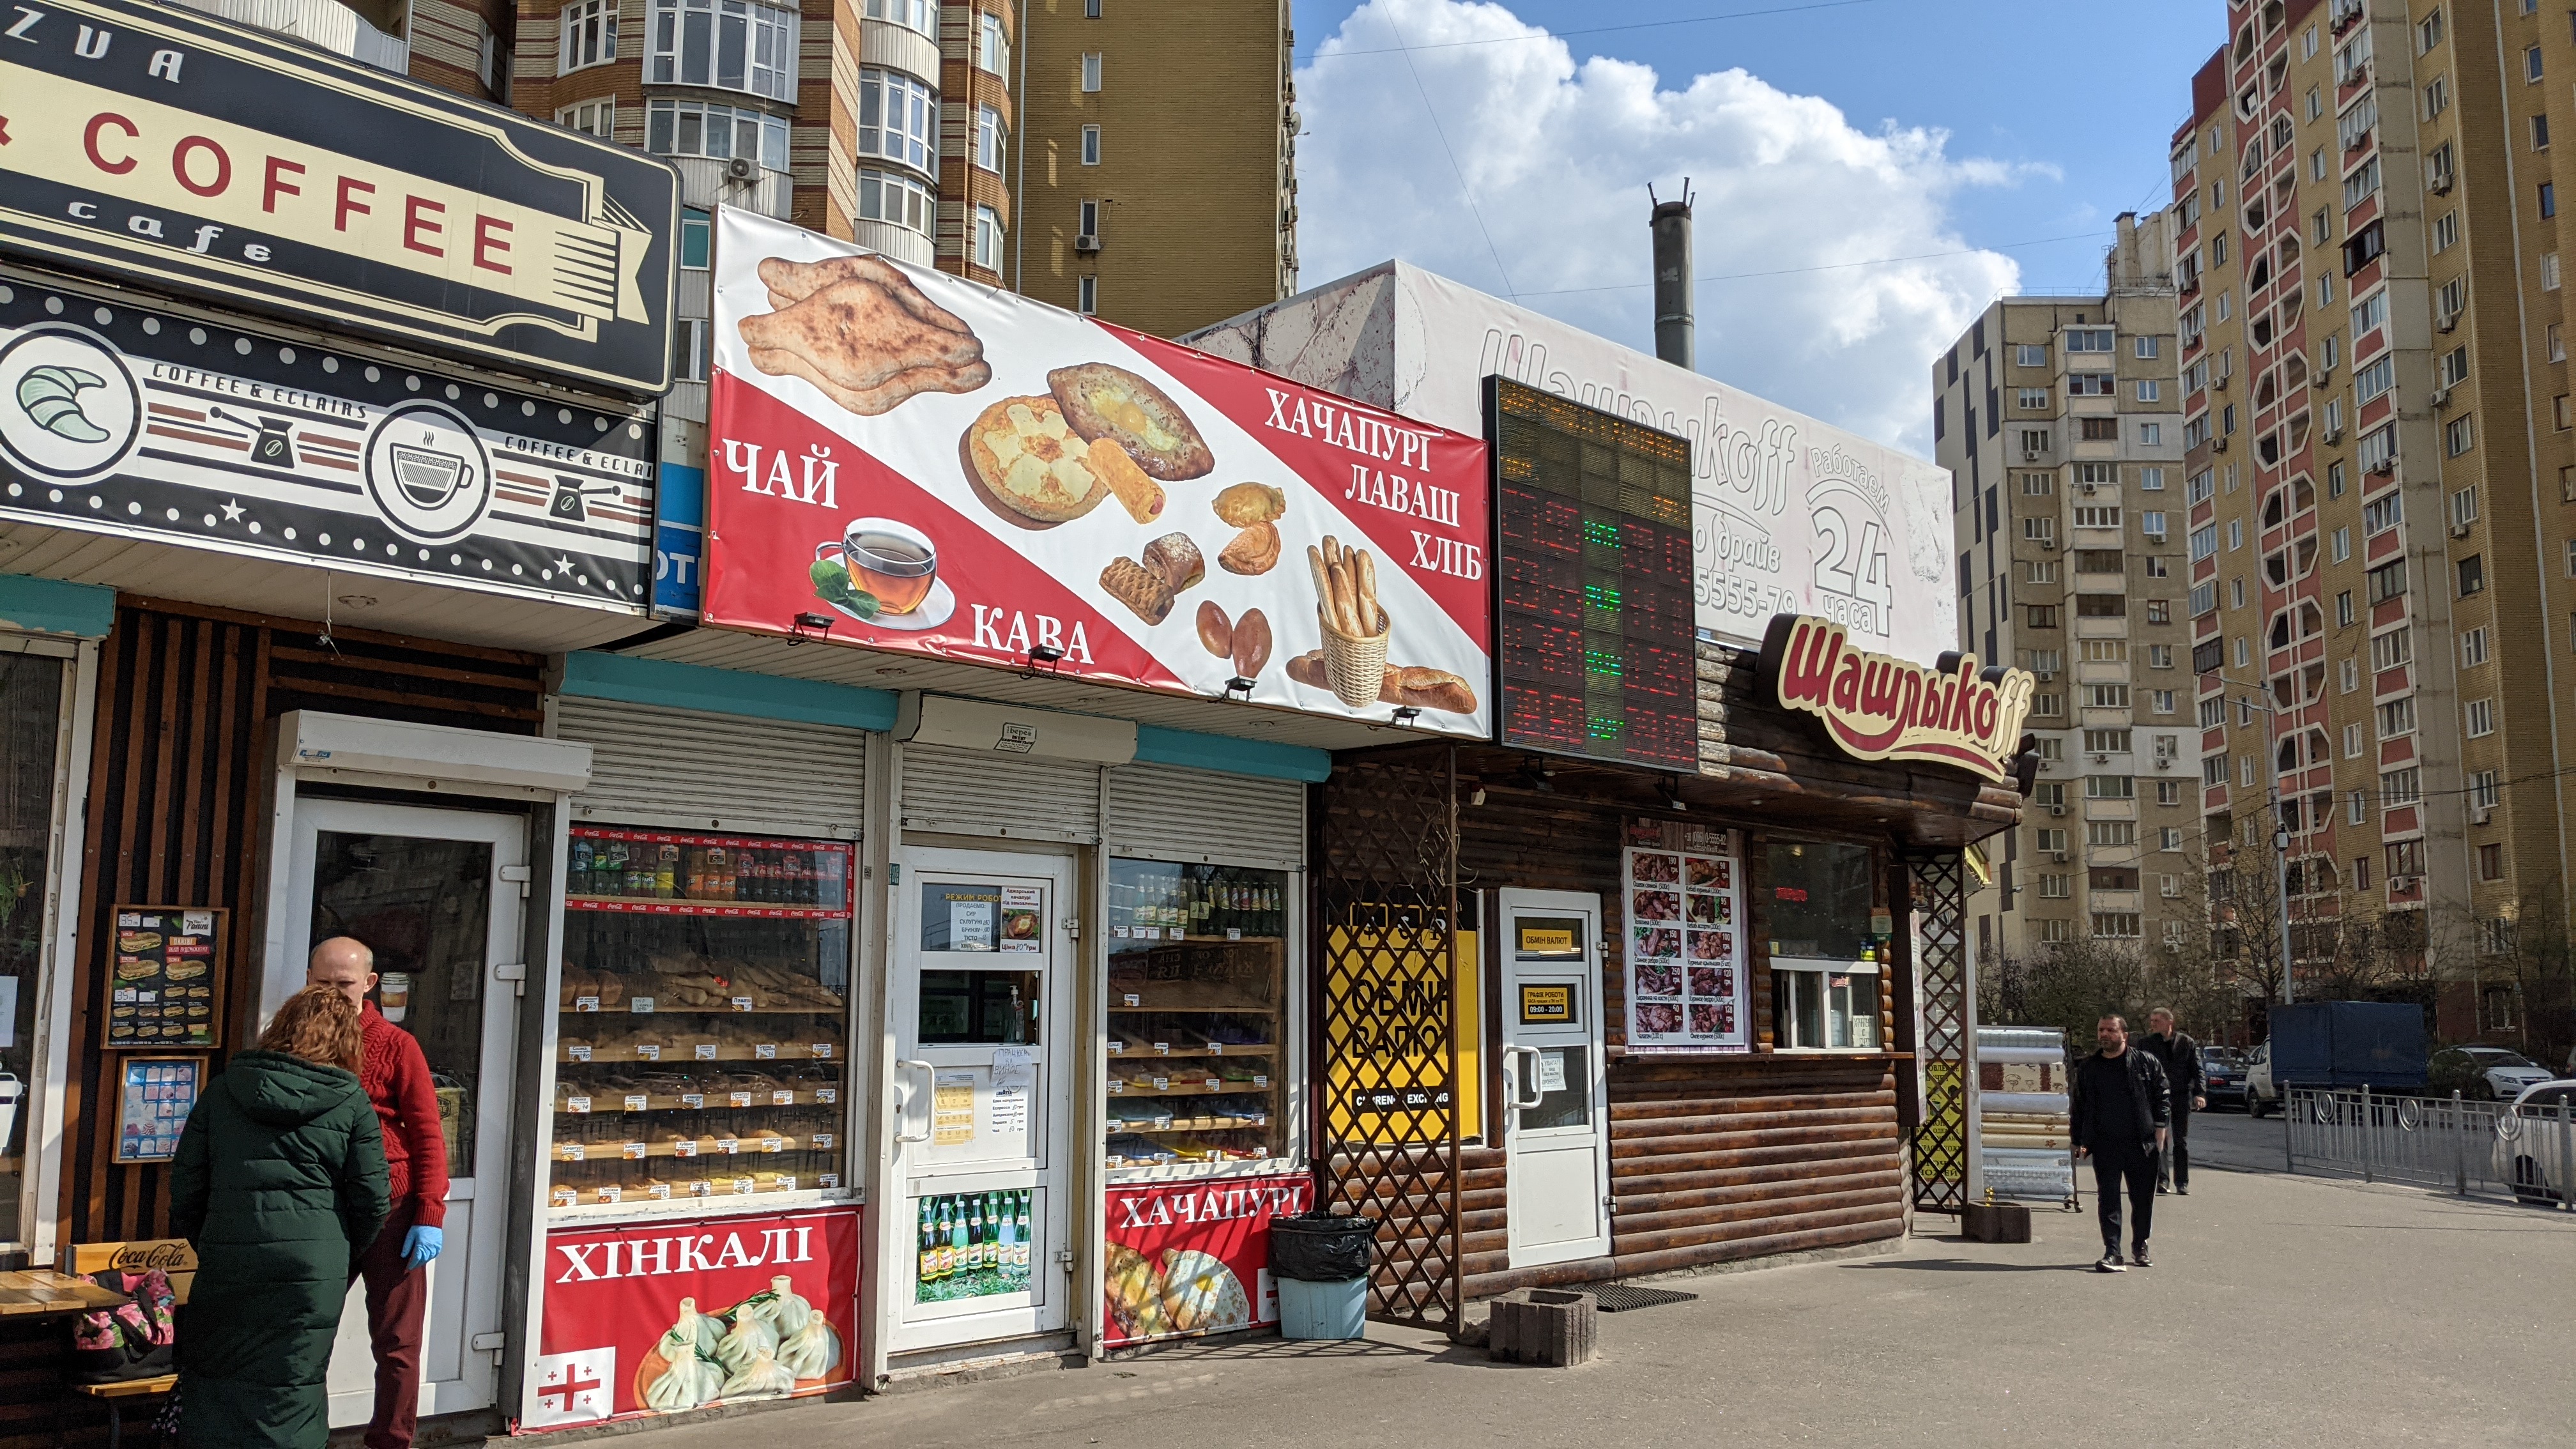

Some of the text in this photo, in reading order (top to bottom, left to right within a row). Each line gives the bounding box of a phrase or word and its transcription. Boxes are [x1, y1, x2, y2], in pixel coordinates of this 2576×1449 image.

[83, 112, 514, 276] COFFEE
[67, 201, 272, 262] cafe
[152, 362, 367, 420] COFFEE & ECLAIRS
[504, 436, 576, 463] COFFEE
[581, 452, 593, 466] &
[1265, 388, 1430, 472] ХАЧАПУРІ
[722, 438, 839, 509] ЧАЙ
[1346, 463, 1460, 527] ЛАВАШ
[1811, 443, 1890, 513] Работаем
[656, 550, 702, 586] ОТ
[1409, 530, 1482, 581] ХЛІБ
[1812, 505, 1892, 638] 24
[970, 604, 1094, 665] КАВА
[1823, 592, 1873, 633] часа
[946, 893, 975, 901] РЕЖИМ
[994, 1065, 1020, 1075] ВИНОС
[1352, 1025, 1447, 1059] ВАЛЮ
[1119, 1185, 1303, 1229] ХАЧАПУРІ
[555, 1226, 813, 1284] ХІНКАЛІ
